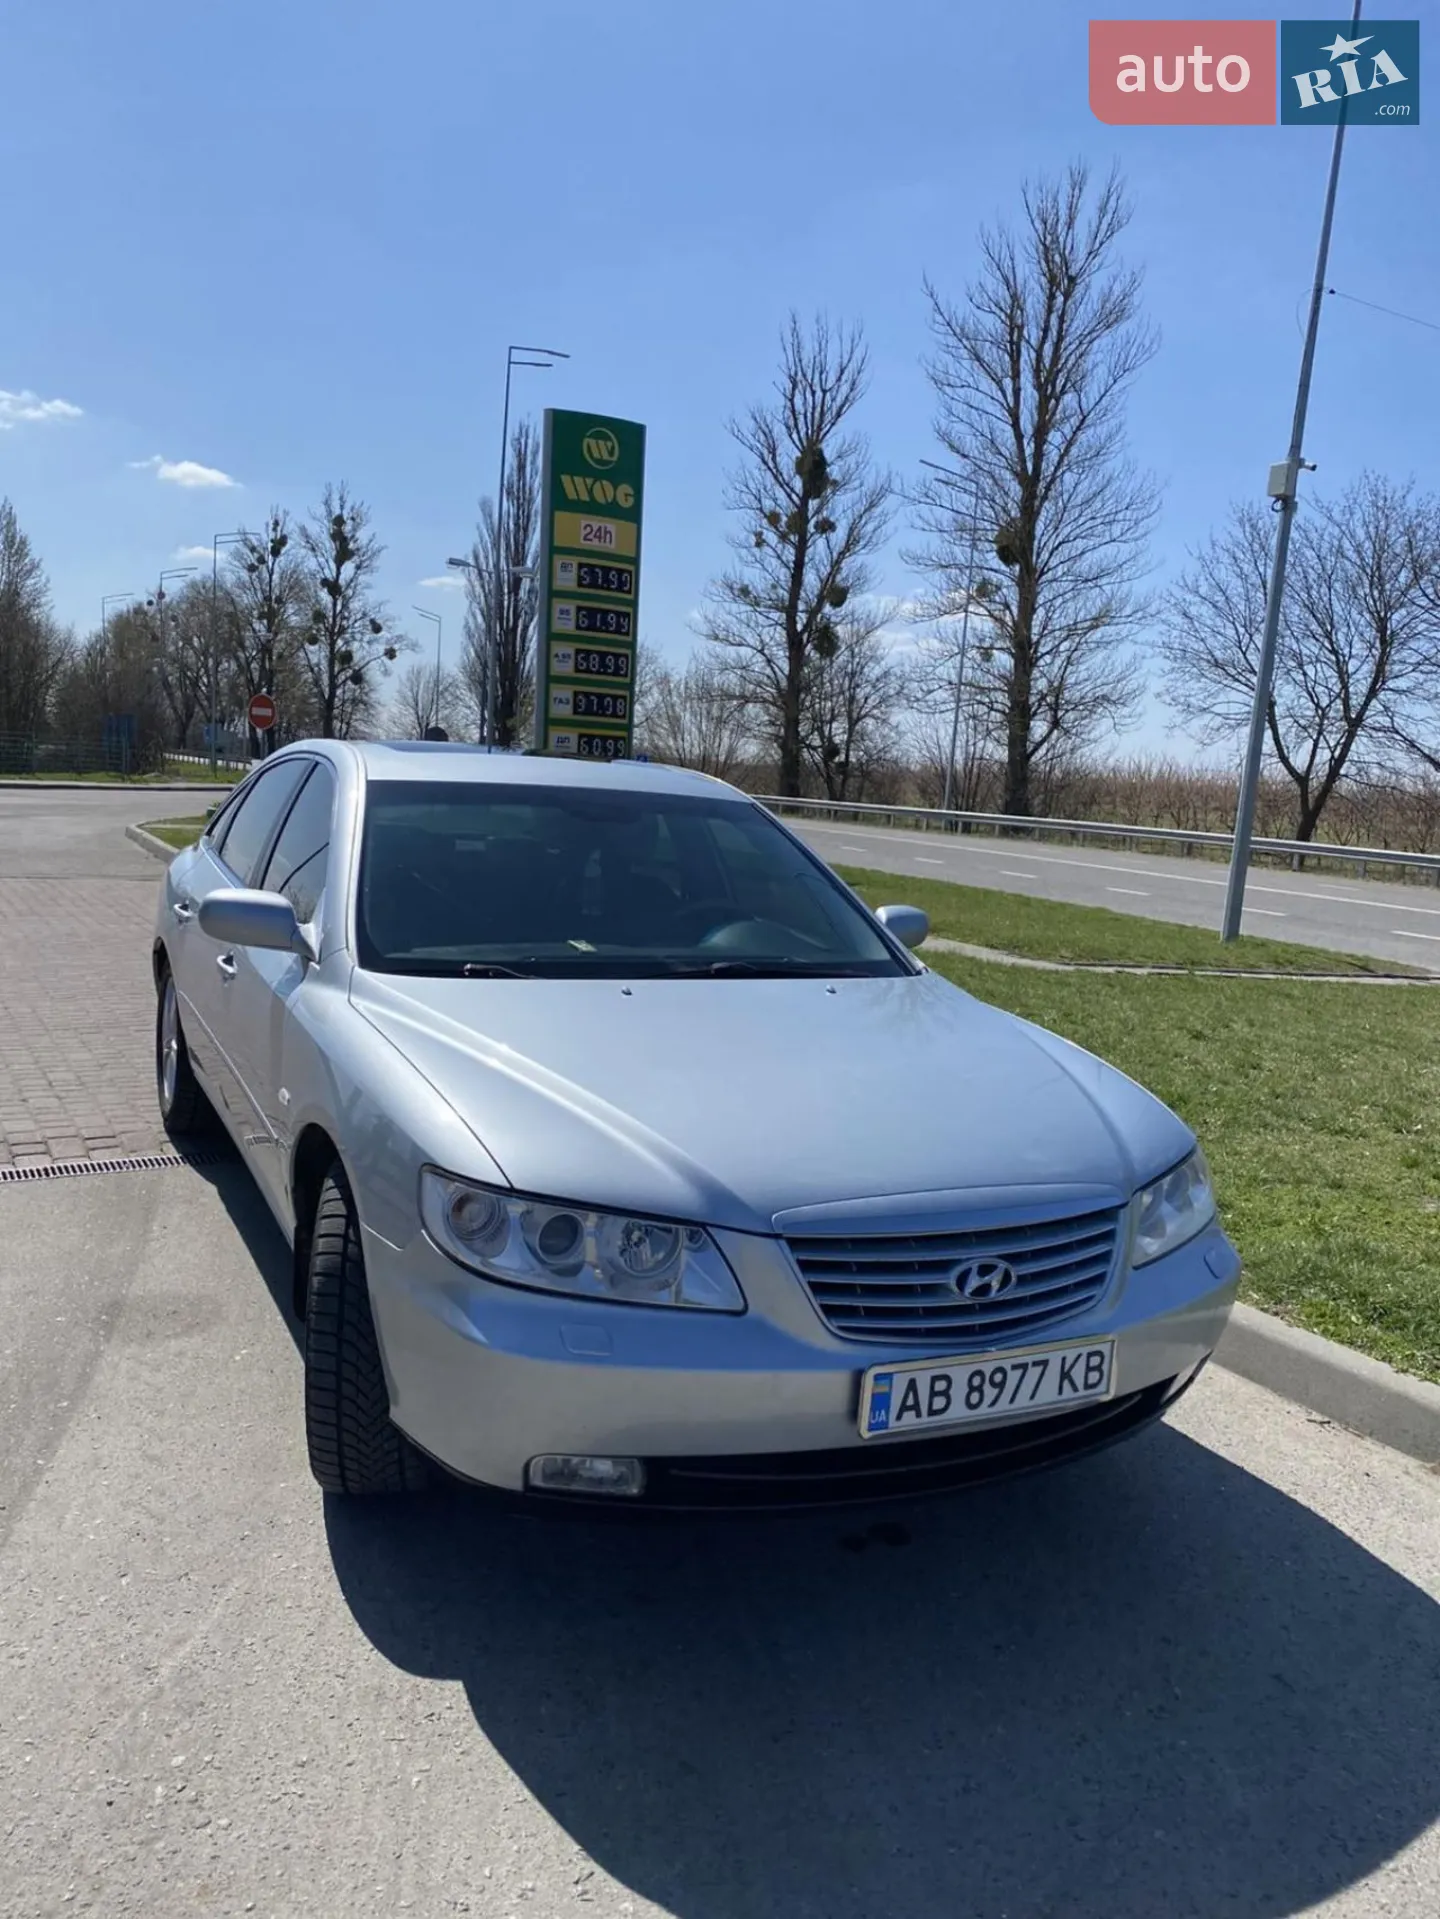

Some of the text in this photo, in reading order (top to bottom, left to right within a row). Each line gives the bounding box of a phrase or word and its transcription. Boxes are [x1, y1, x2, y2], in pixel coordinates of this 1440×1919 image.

[560, 474, 635, 508] WOG
[582, 523, 613, 545] 24h
[895, 1350, 1105, 1422] AB 8977 KB
[870, 1410, 887, 1424] UA
